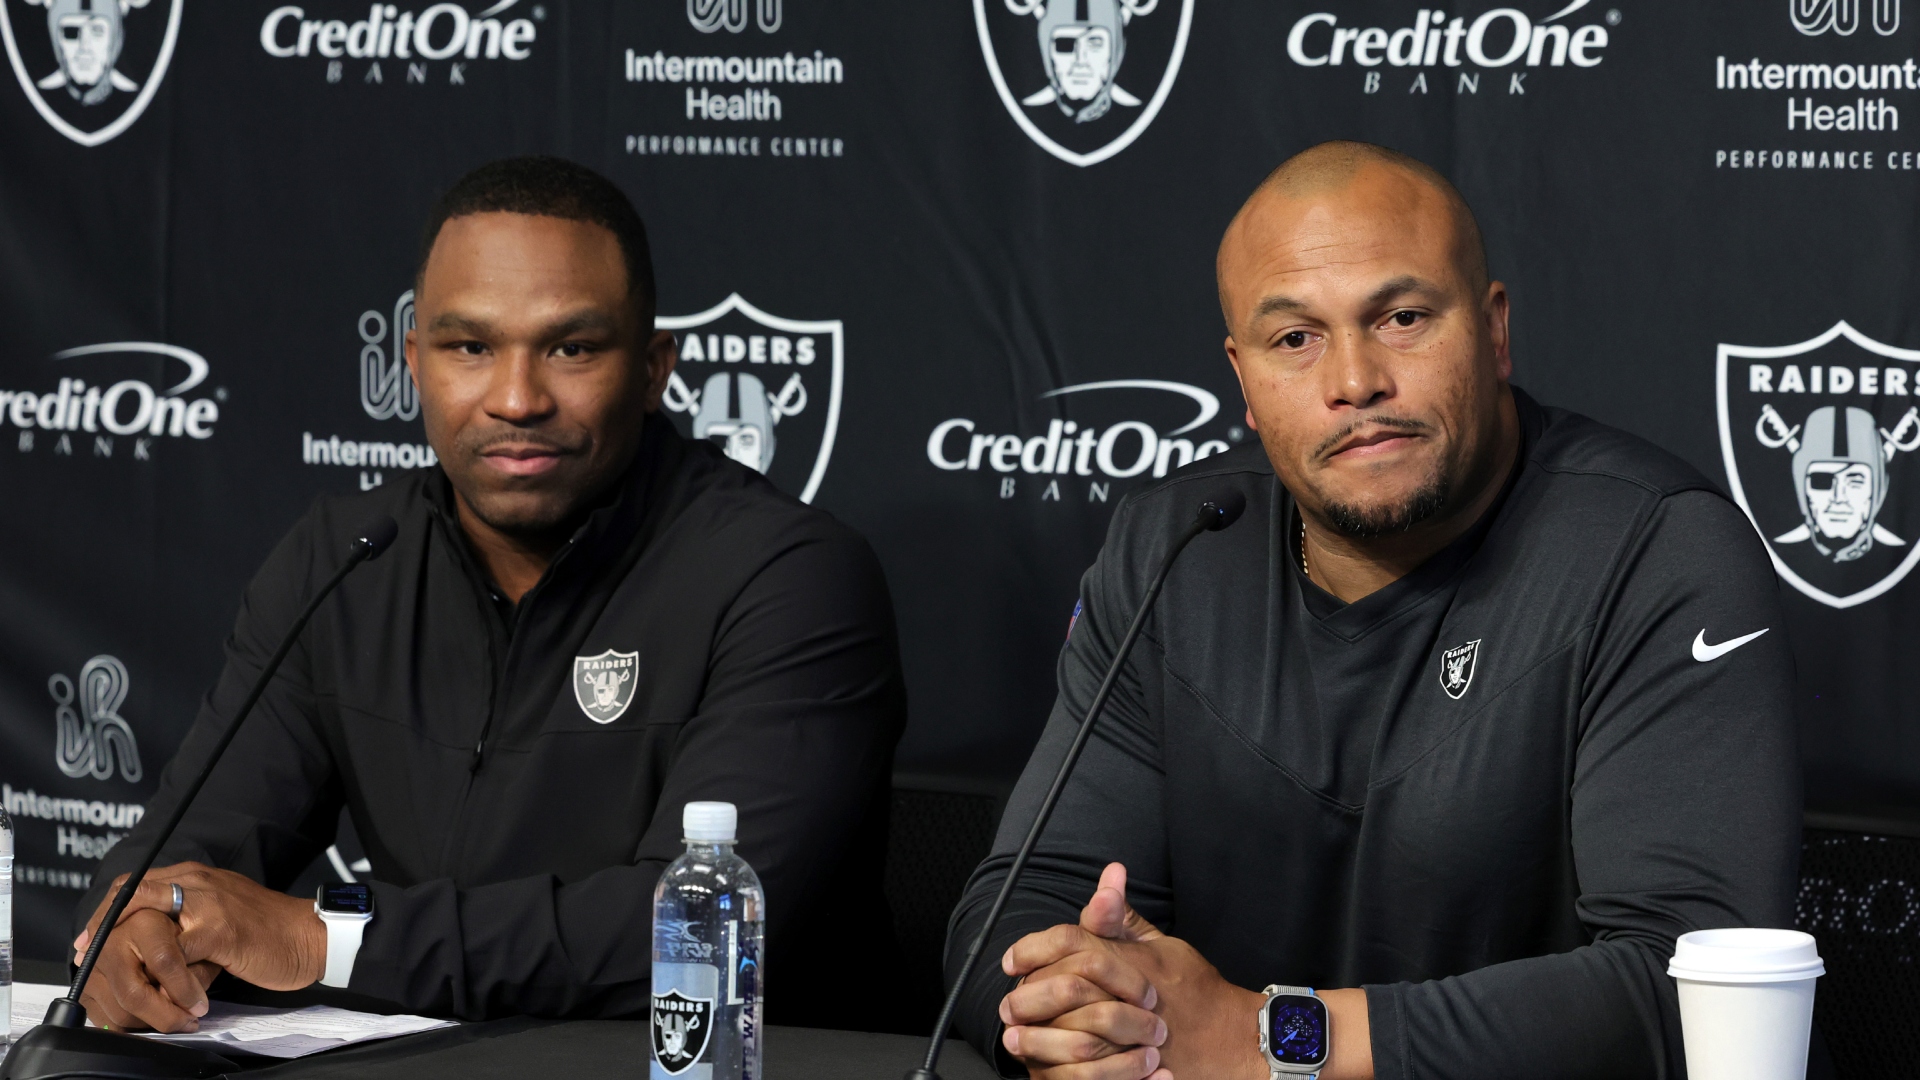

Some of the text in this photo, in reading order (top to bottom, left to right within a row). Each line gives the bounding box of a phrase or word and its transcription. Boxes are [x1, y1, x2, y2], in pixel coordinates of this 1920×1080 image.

[260, 3, 536, 60] CreditOne
[1286, 9, 1608, 67] CreditOne
[326, 61, 467, 85] BANK
[625, 48, 844, 83] Intermountain
[1716, 55, 1920, 90] Intermount
[1363, 71, 1527, 95] BANK
[685, 86, 782, 121] Health
[1787, 96, 1899, 131] Health
[625, 135, 844, 157] PERFORMANCE CENTER
[1715, 149, 1920, 170] PERFORMANCE CE
[674, 333, 816, 366] AIDERS
[18, 430, 152, 461] BANK
[302, 431, 438, 469] Intermou
[999, 476, 1109, 503] BAN
[583, 658, 633, 670] RAIDERS
[1447, 643, 1475, 659] RAIDERS
[2, 783, 146, 829] Intermoun
